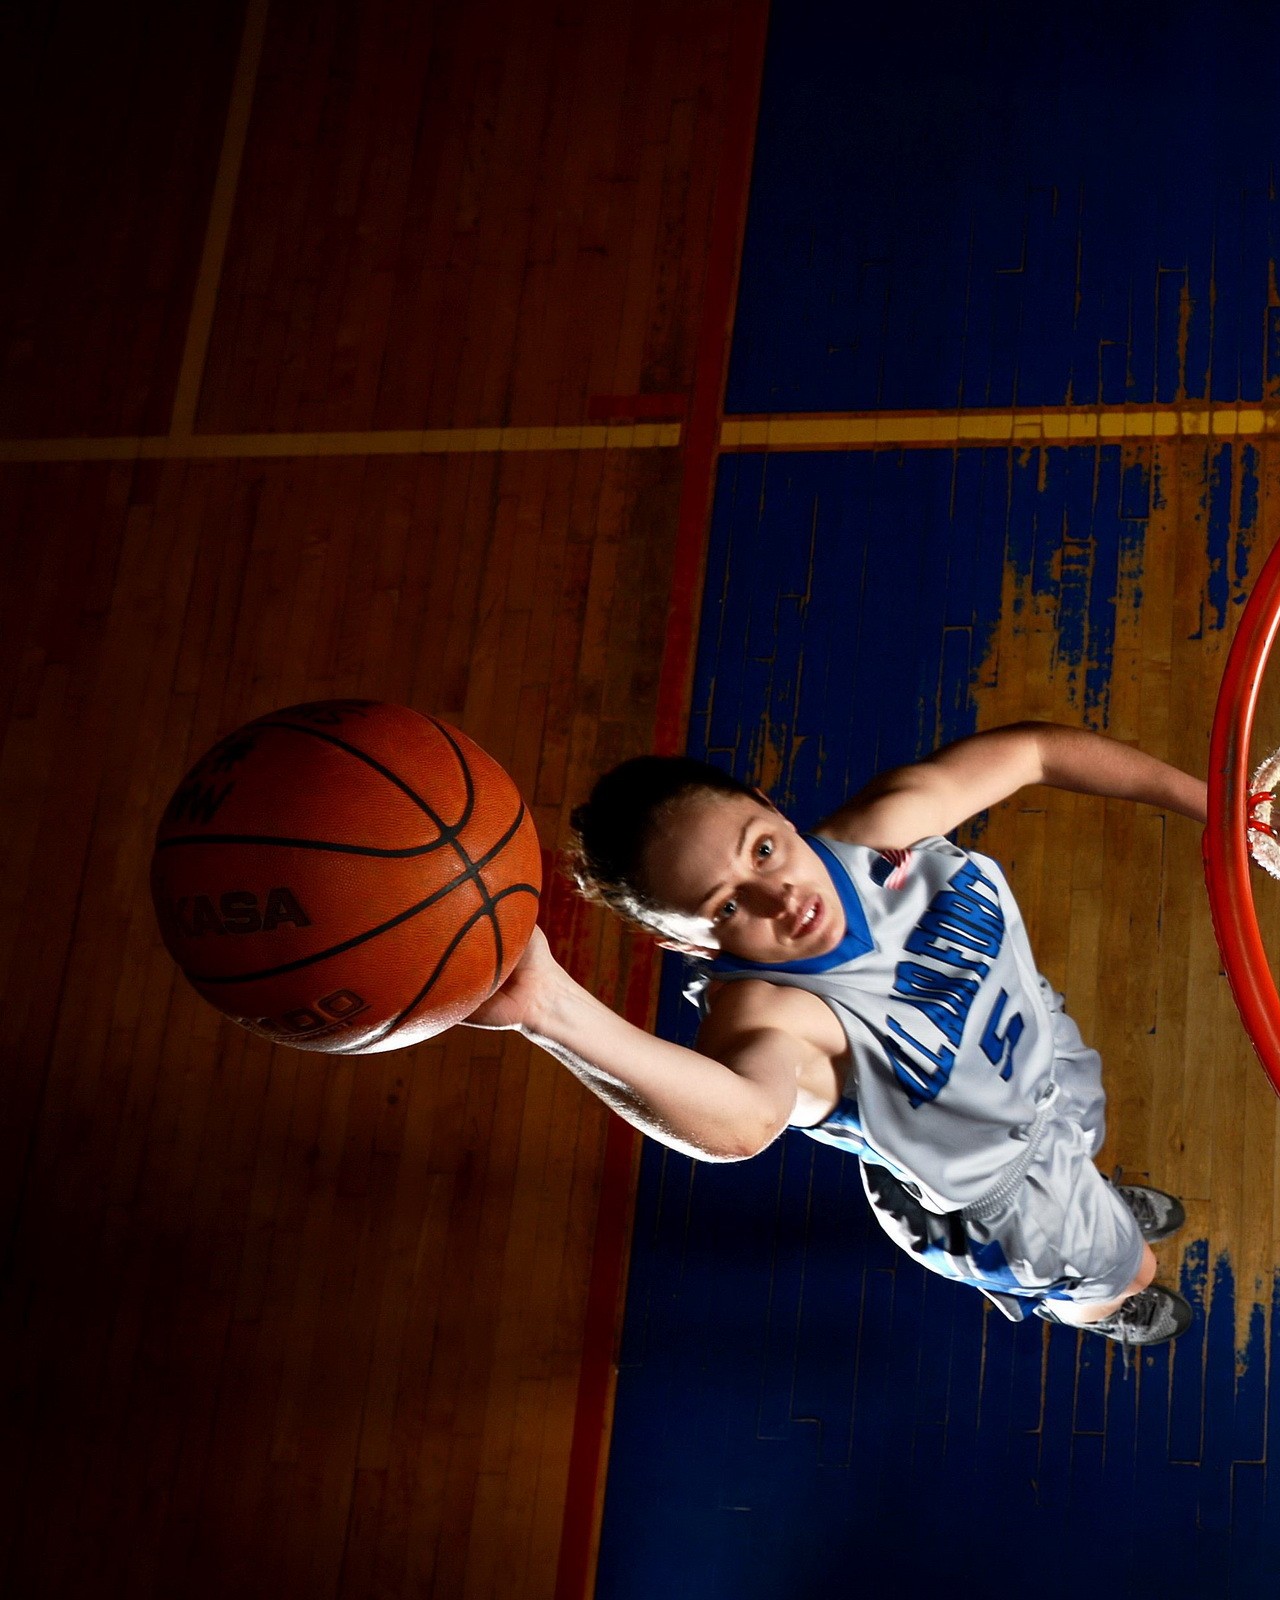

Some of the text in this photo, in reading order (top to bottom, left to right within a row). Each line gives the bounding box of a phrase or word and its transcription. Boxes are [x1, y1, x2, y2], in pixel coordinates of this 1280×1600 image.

[888, 961, 980, 1049] AIR
[979, 988, 1025, 1082] 5
[885, 1014, 957, 1110] ALL
